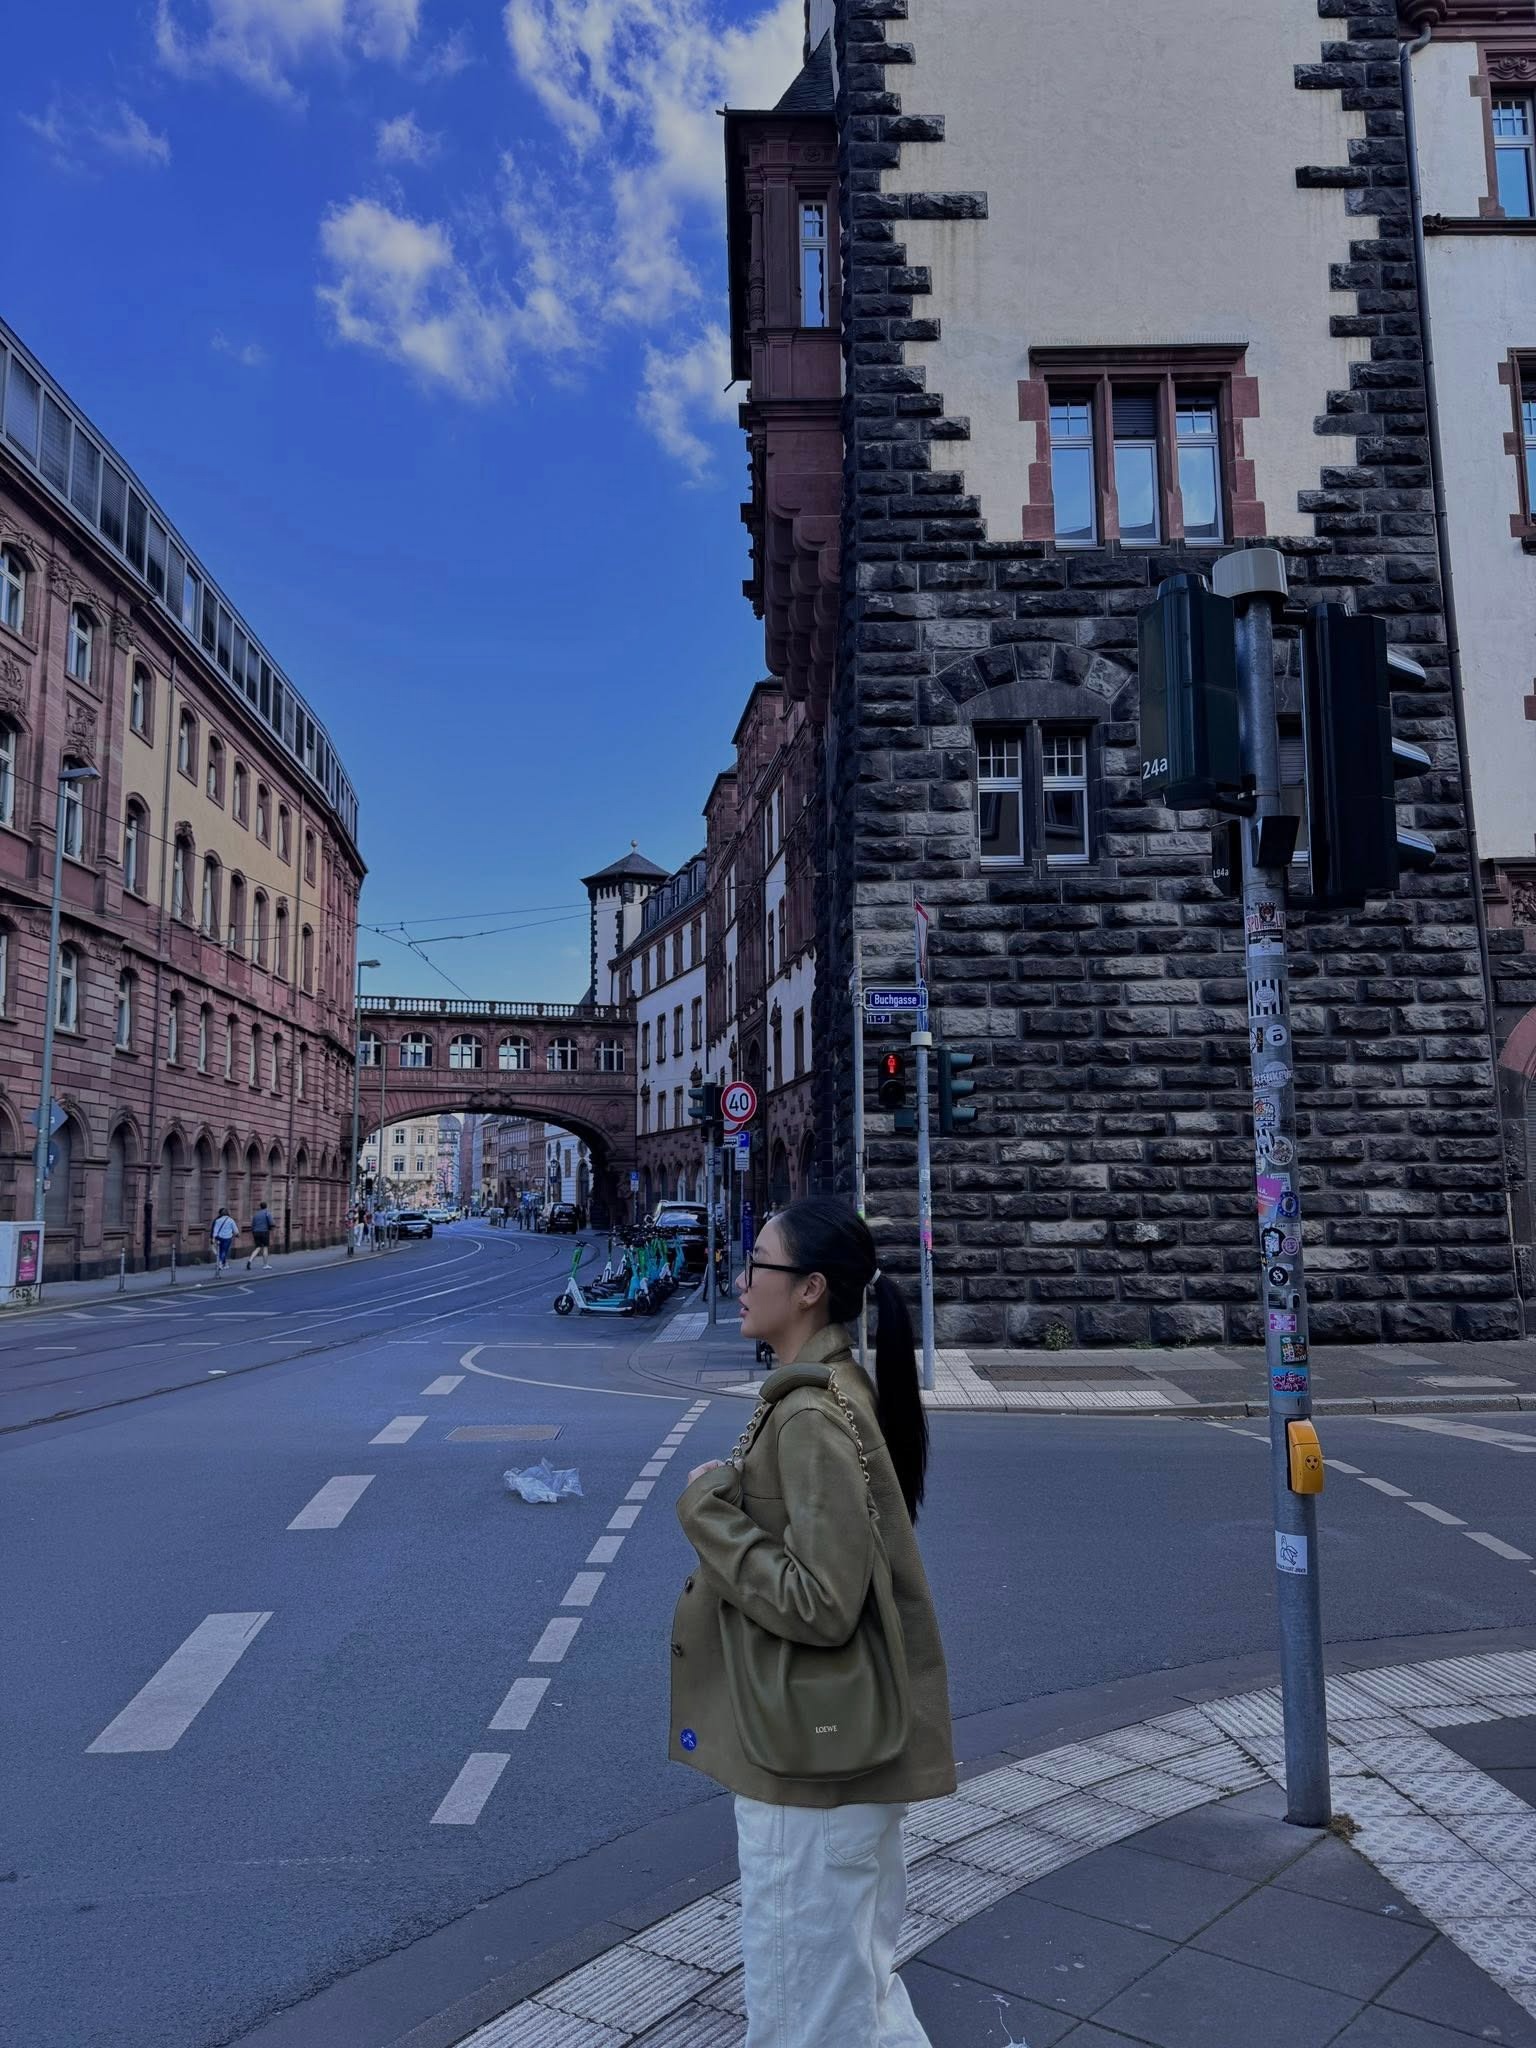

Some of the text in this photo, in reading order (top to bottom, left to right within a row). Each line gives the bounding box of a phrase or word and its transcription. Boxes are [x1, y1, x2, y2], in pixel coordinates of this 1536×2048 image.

[1142, 757, 1168, 780] 24a
[875, 994, 917, 1007] Buchgasse
[729, 1093, 749, 1112] 40
[815, 1725, 838, 1734] LOEWE
